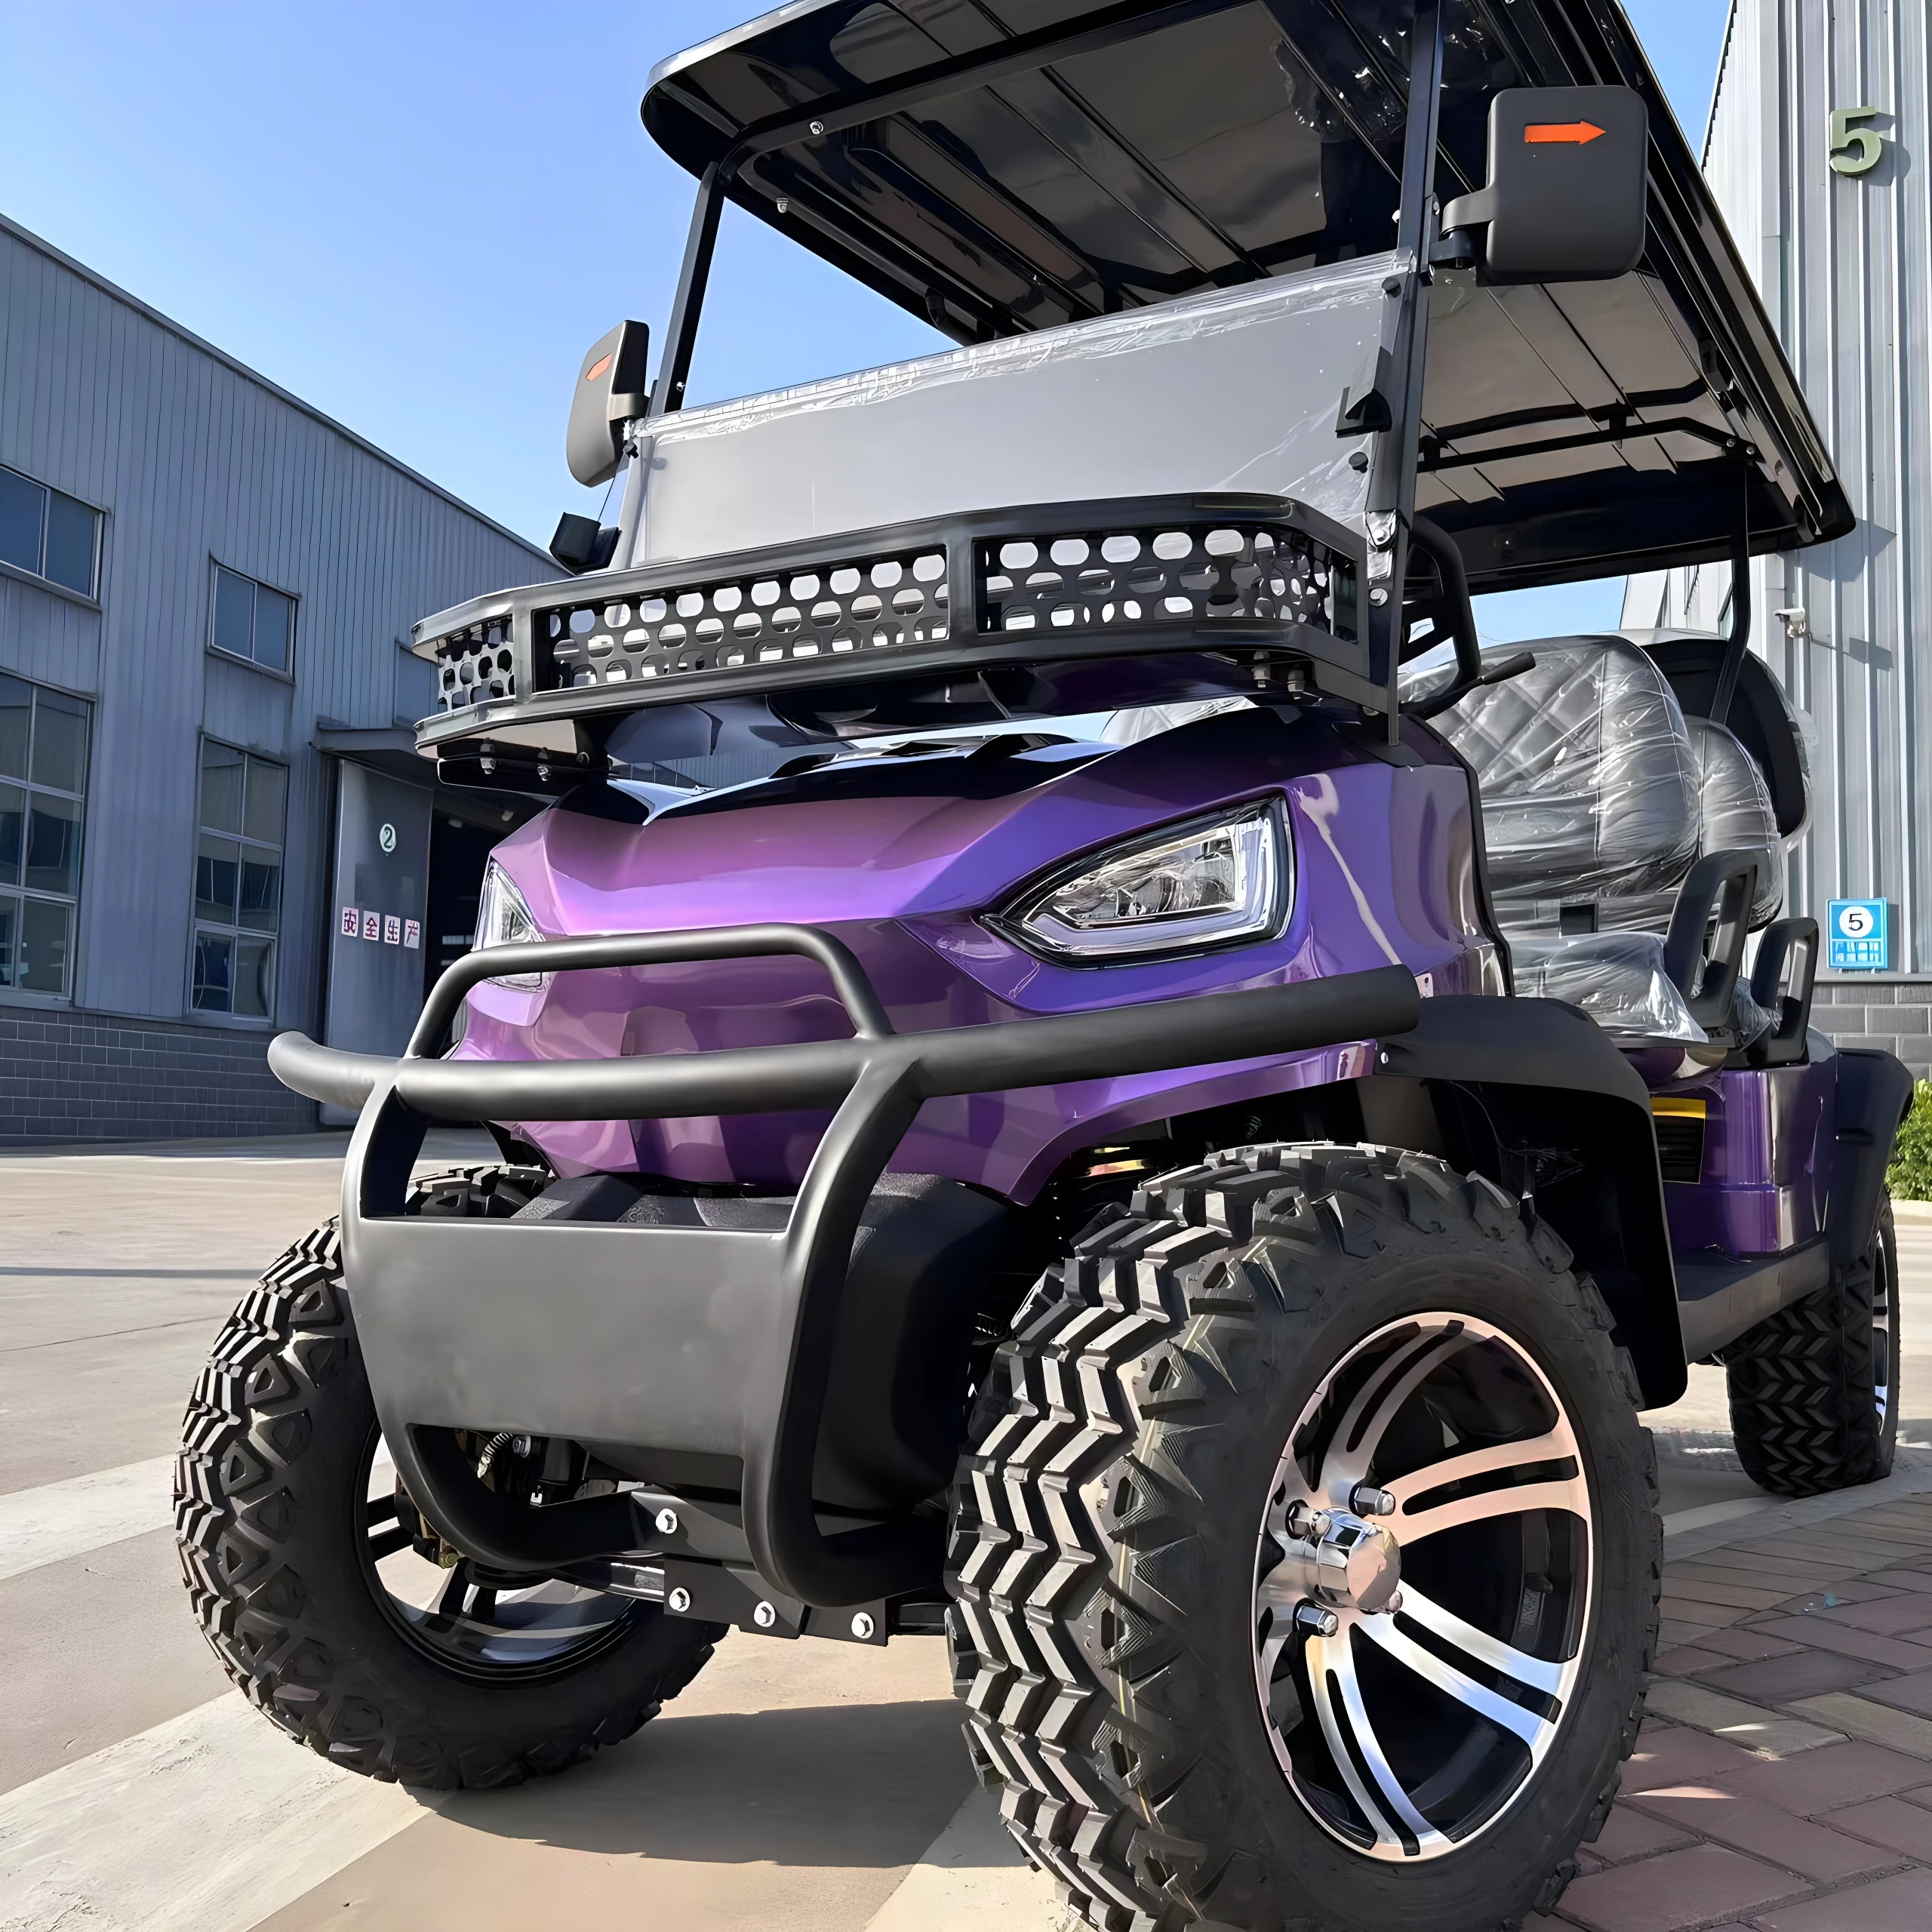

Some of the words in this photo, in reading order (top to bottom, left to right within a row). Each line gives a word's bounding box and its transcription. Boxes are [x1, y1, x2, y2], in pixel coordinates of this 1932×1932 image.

[1829, 106, 1882, 176] 5
[343, 909, 419, 945] 安全生产
[1848, 912, 1863, 931] 5
